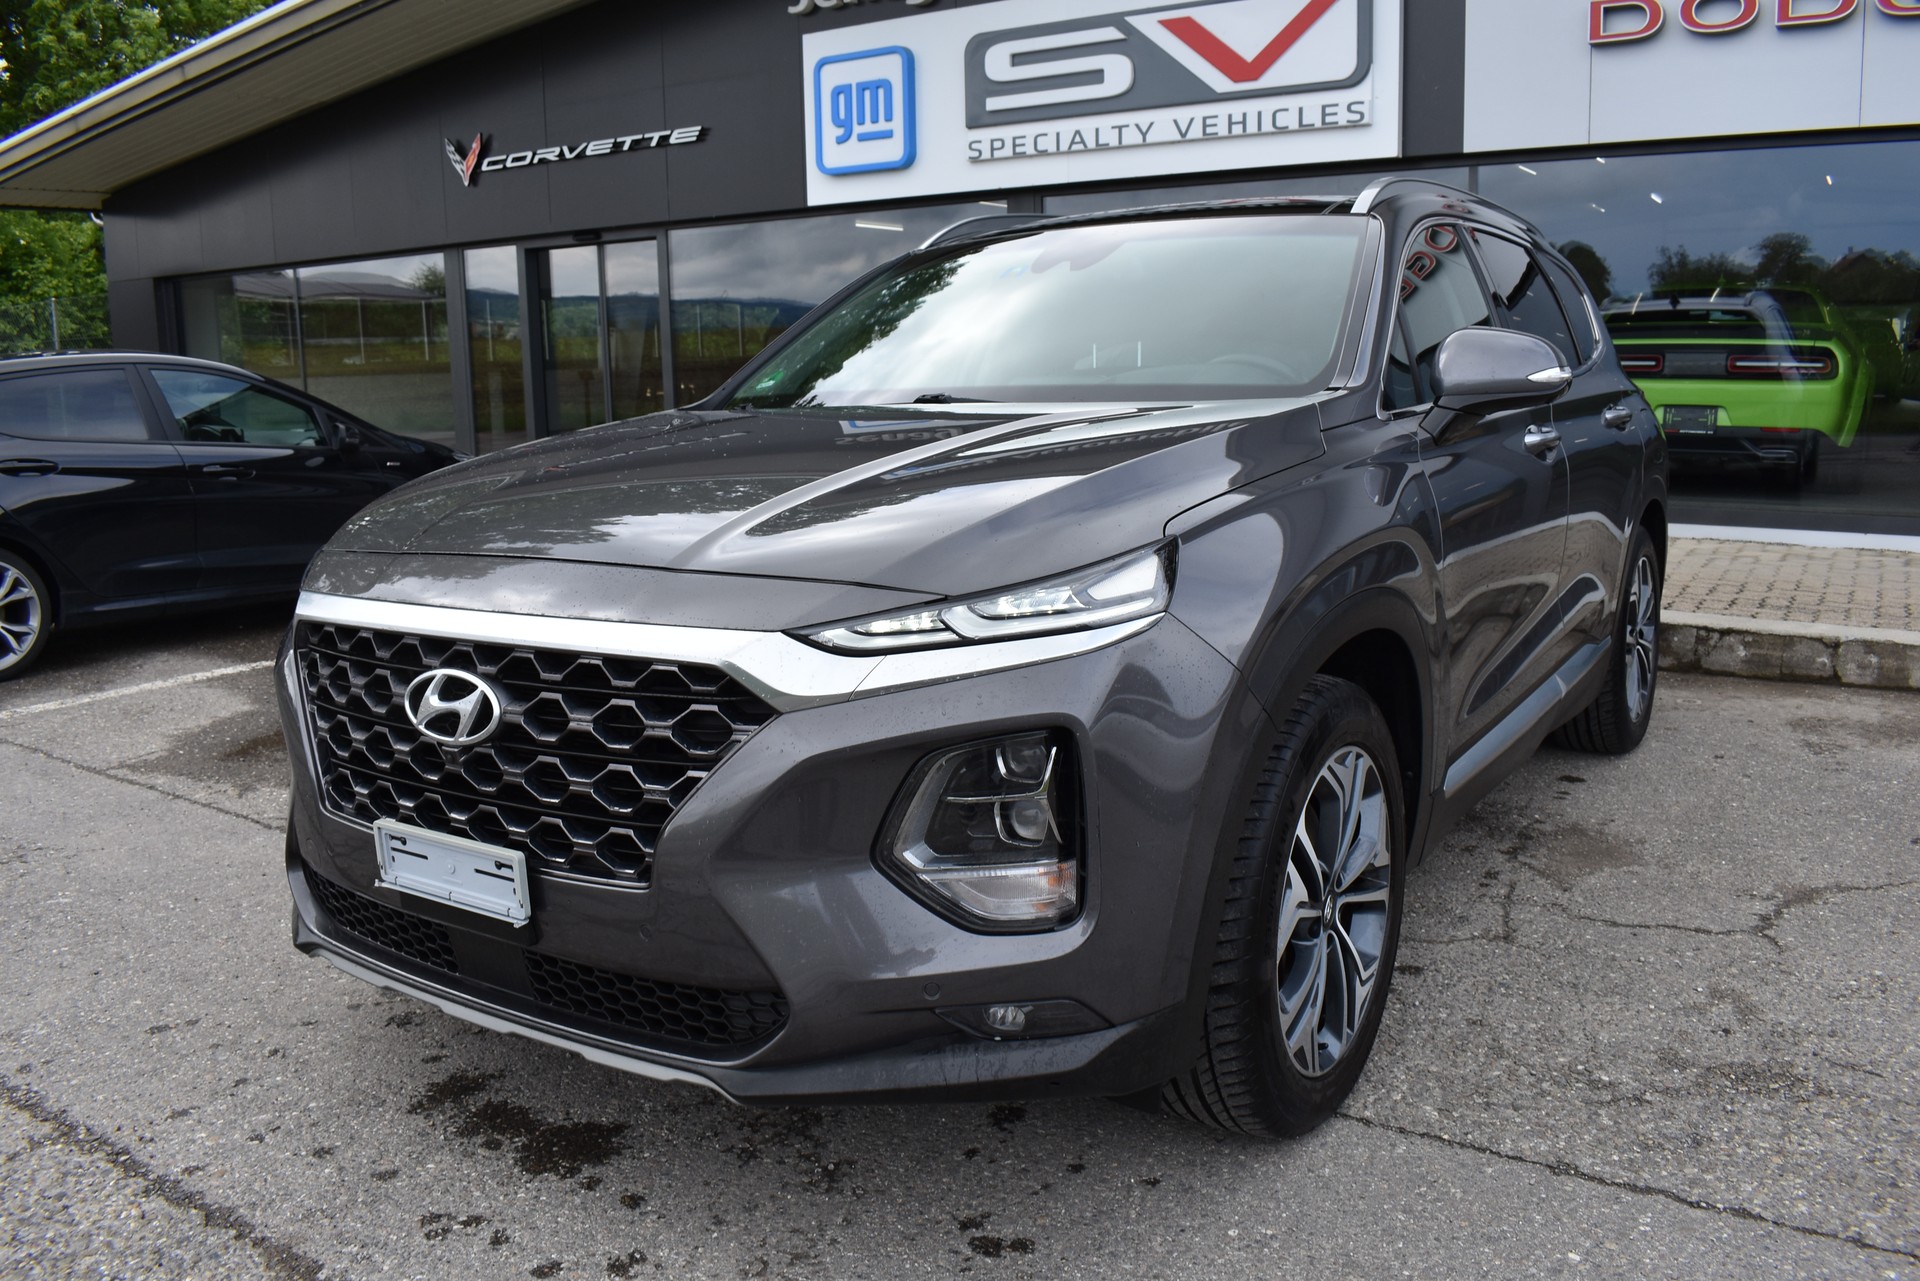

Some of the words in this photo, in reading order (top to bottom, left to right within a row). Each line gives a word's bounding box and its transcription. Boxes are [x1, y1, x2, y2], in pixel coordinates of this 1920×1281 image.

[831, 77, 894, 145] gm
[967, 120, 1155, 162] SPECIALTY
[1172, 100, 1367, 140] VEHICLES
[481, 125, 702, 172] CORVETTE
